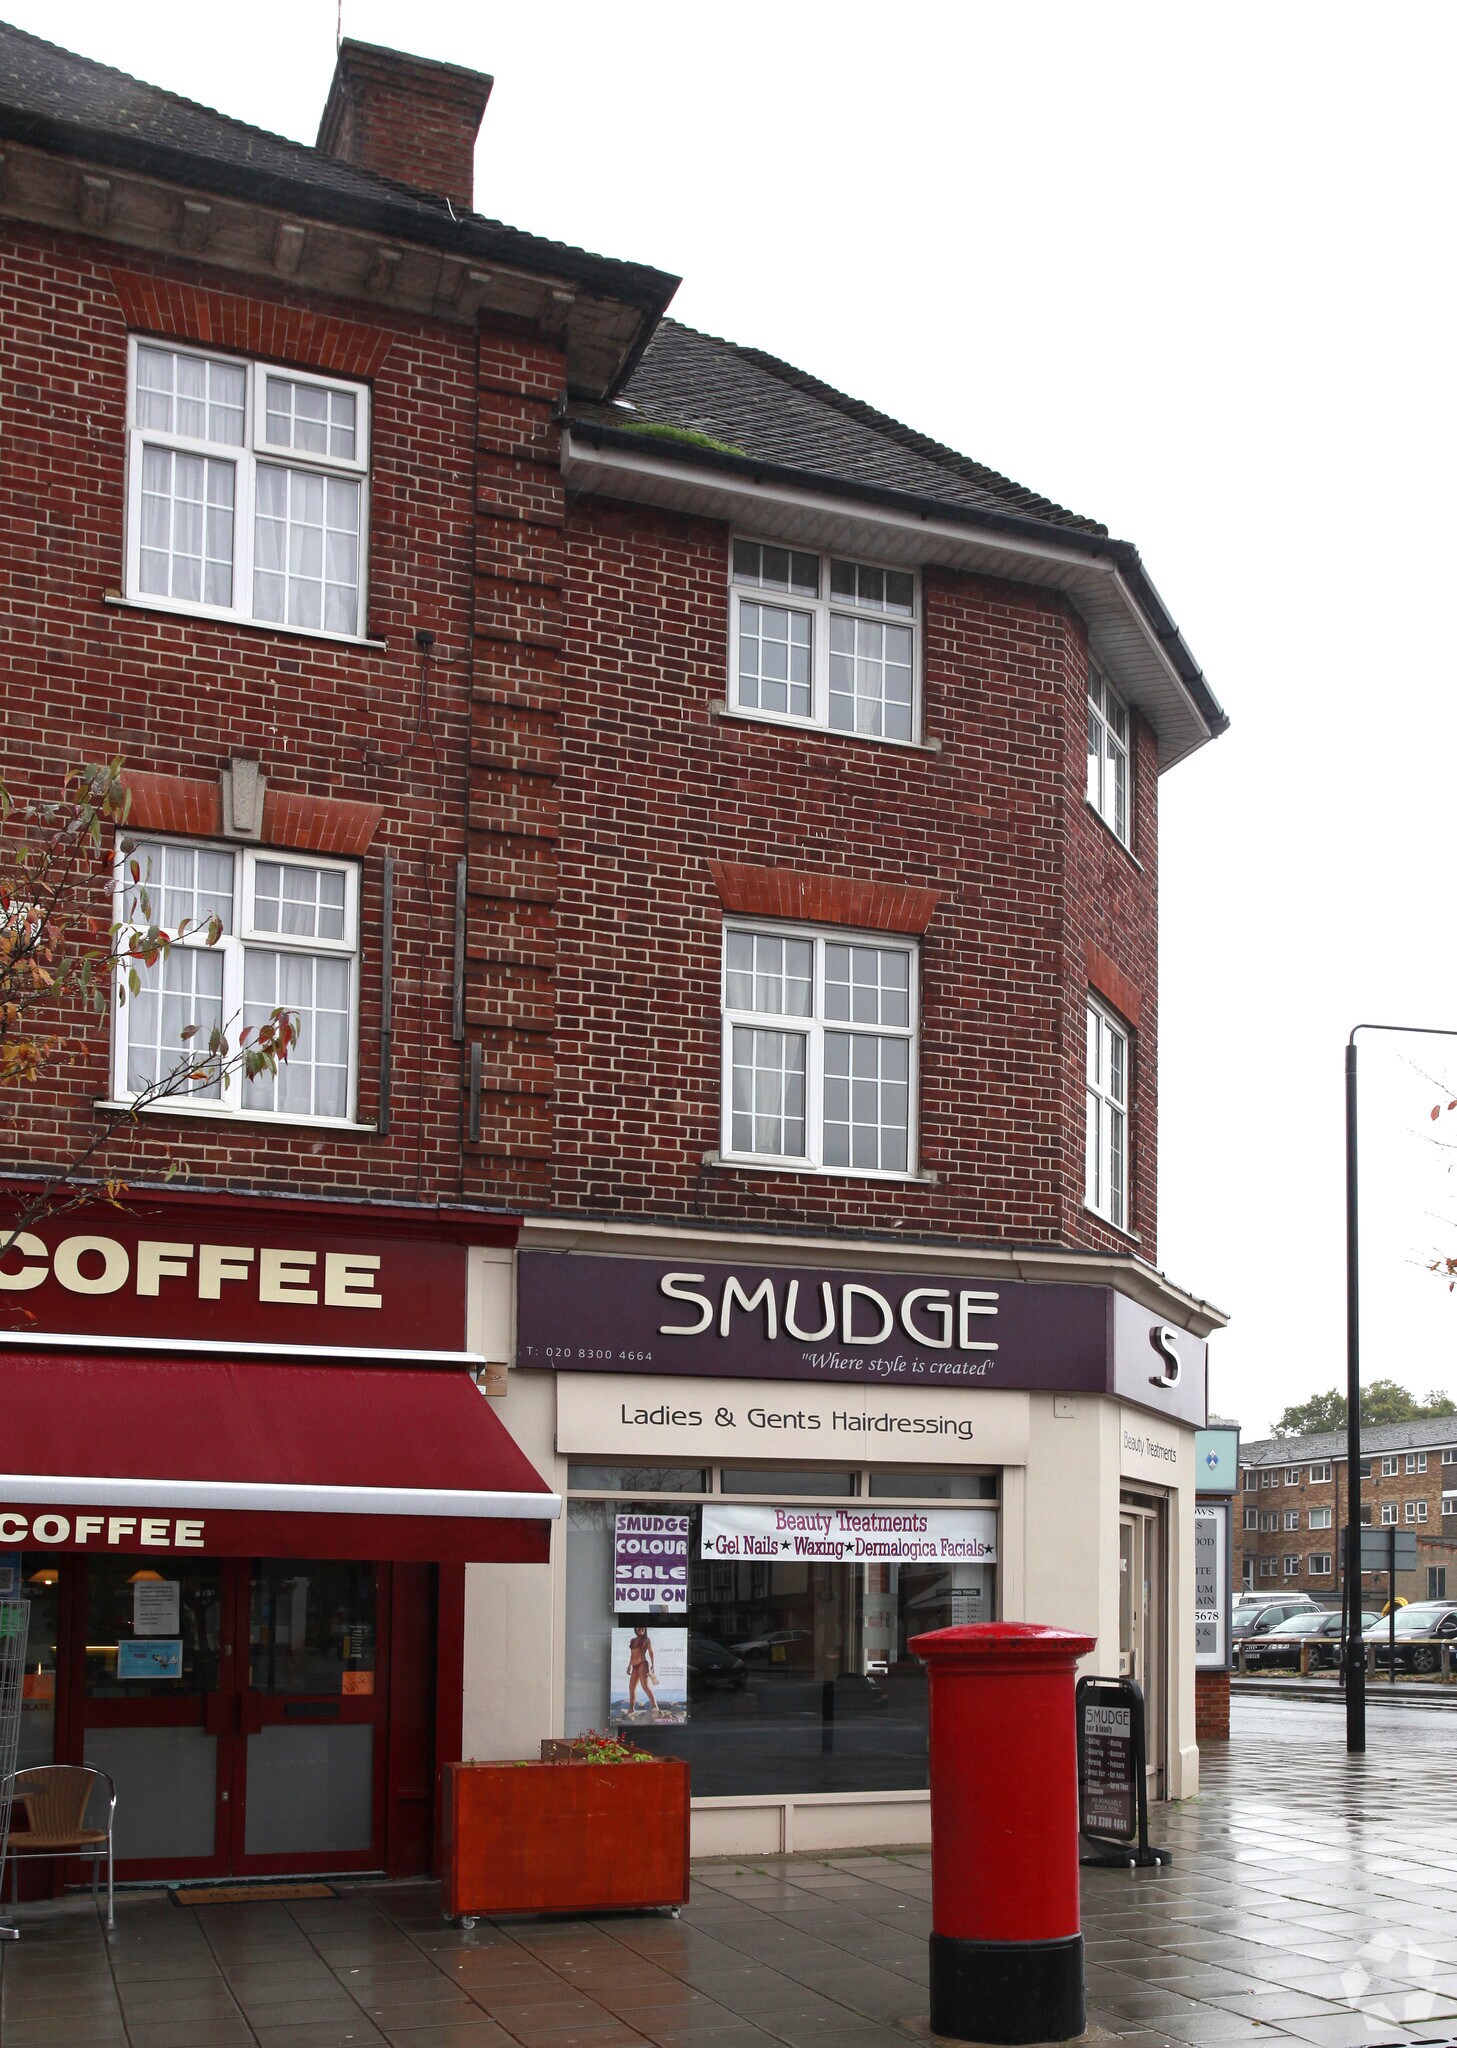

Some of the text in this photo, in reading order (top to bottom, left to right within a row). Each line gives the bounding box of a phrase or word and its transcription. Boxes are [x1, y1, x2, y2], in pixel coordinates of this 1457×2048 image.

[0, 1230, 382, 1308] COFFEE
[659, 1272, 999, 1350] SMUDGE
[526, 1346, 652, 1361] T: 020 8300 4664
[801, 1352, 995, 1377] "Where style is created"
[1149, 1326, 1181, 1388] S
[621, 1404, 974, 1440] Ladies & Gents Hairdressing
[1123, 1431, 1176, 1462] Beauty Treatments
[0, 1513, 204, 1547] COFFEE
[617, 1516, 688, 1532] SMUDGE
[775, 1509, 927, 1536] Beauty Treatments
[616, 1539, 687, 1555] COLOUR
[715, 1535, 985, 1561] Gel Nails Waxing Dermalogica Facials
[616, 1565, 686, 1580] SALE
[616, 1587, 685, 1602] NOW ON
[1086, 1709, 1129, 1725] SMUDGE
